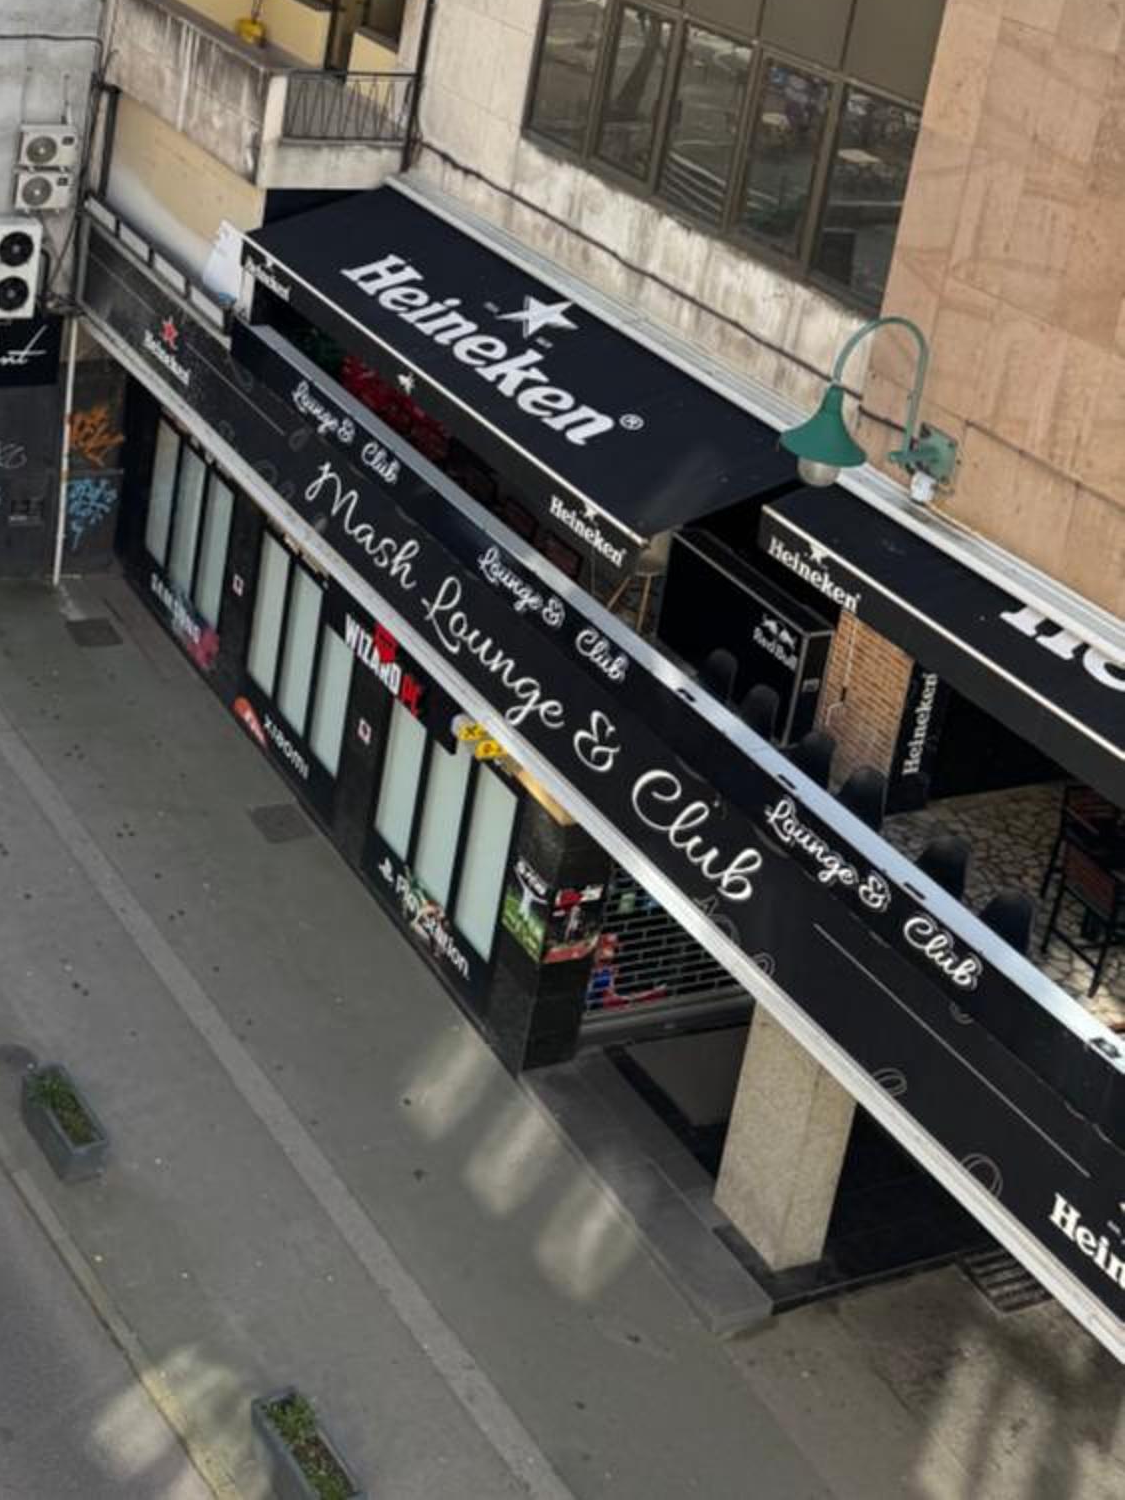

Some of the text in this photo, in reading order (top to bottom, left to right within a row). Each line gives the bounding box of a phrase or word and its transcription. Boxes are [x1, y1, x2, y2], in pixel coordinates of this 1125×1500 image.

[291, 380, 401, 485] Lounge & Club
[549, 494, 628, 569] Heineken
[767, 536, 862, 615] Heineken
[478, 546, 629, 682] Lounge & Club
[304, 461, 763, 900] Mash Lounge & Club
[901, 671, 938, 776] Heineken
[765, 796, 982, 988] Lounge & Club
